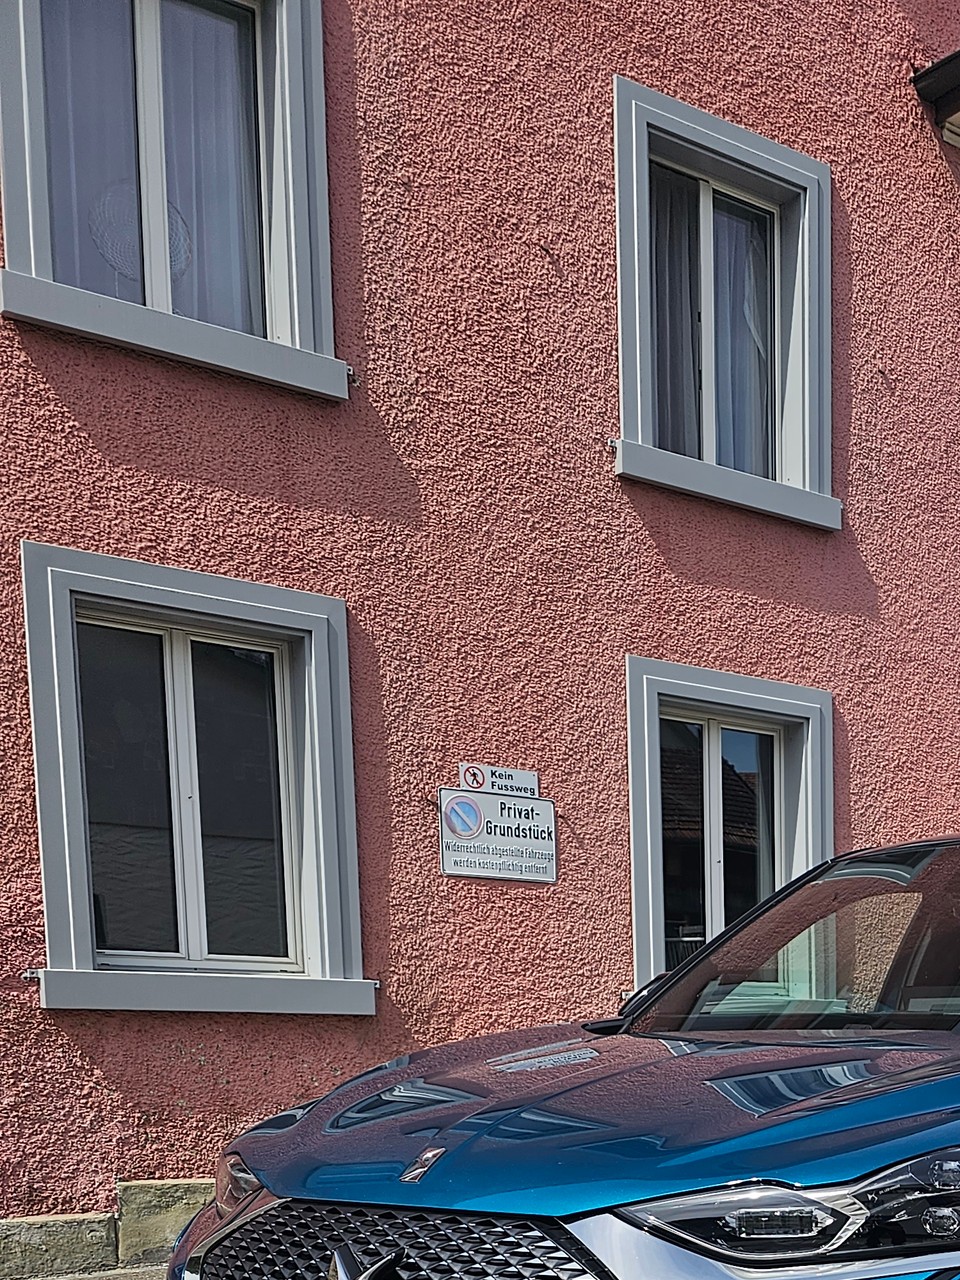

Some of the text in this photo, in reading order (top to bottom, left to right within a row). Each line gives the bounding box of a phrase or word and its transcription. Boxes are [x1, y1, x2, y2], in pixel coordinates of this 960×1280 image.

[490, 769, 514, 781] Kein
[491, 781, 536, 796] Fussweg
[500, 801, 540, 820] Privat-
[485, 820, 553, 841] Grundstück
[444, 841, 554, 862] Widerrechtlich abgestellte Fahrzeuge
[452, 858, 548, 875] werden kostenpflichtig entfernt
